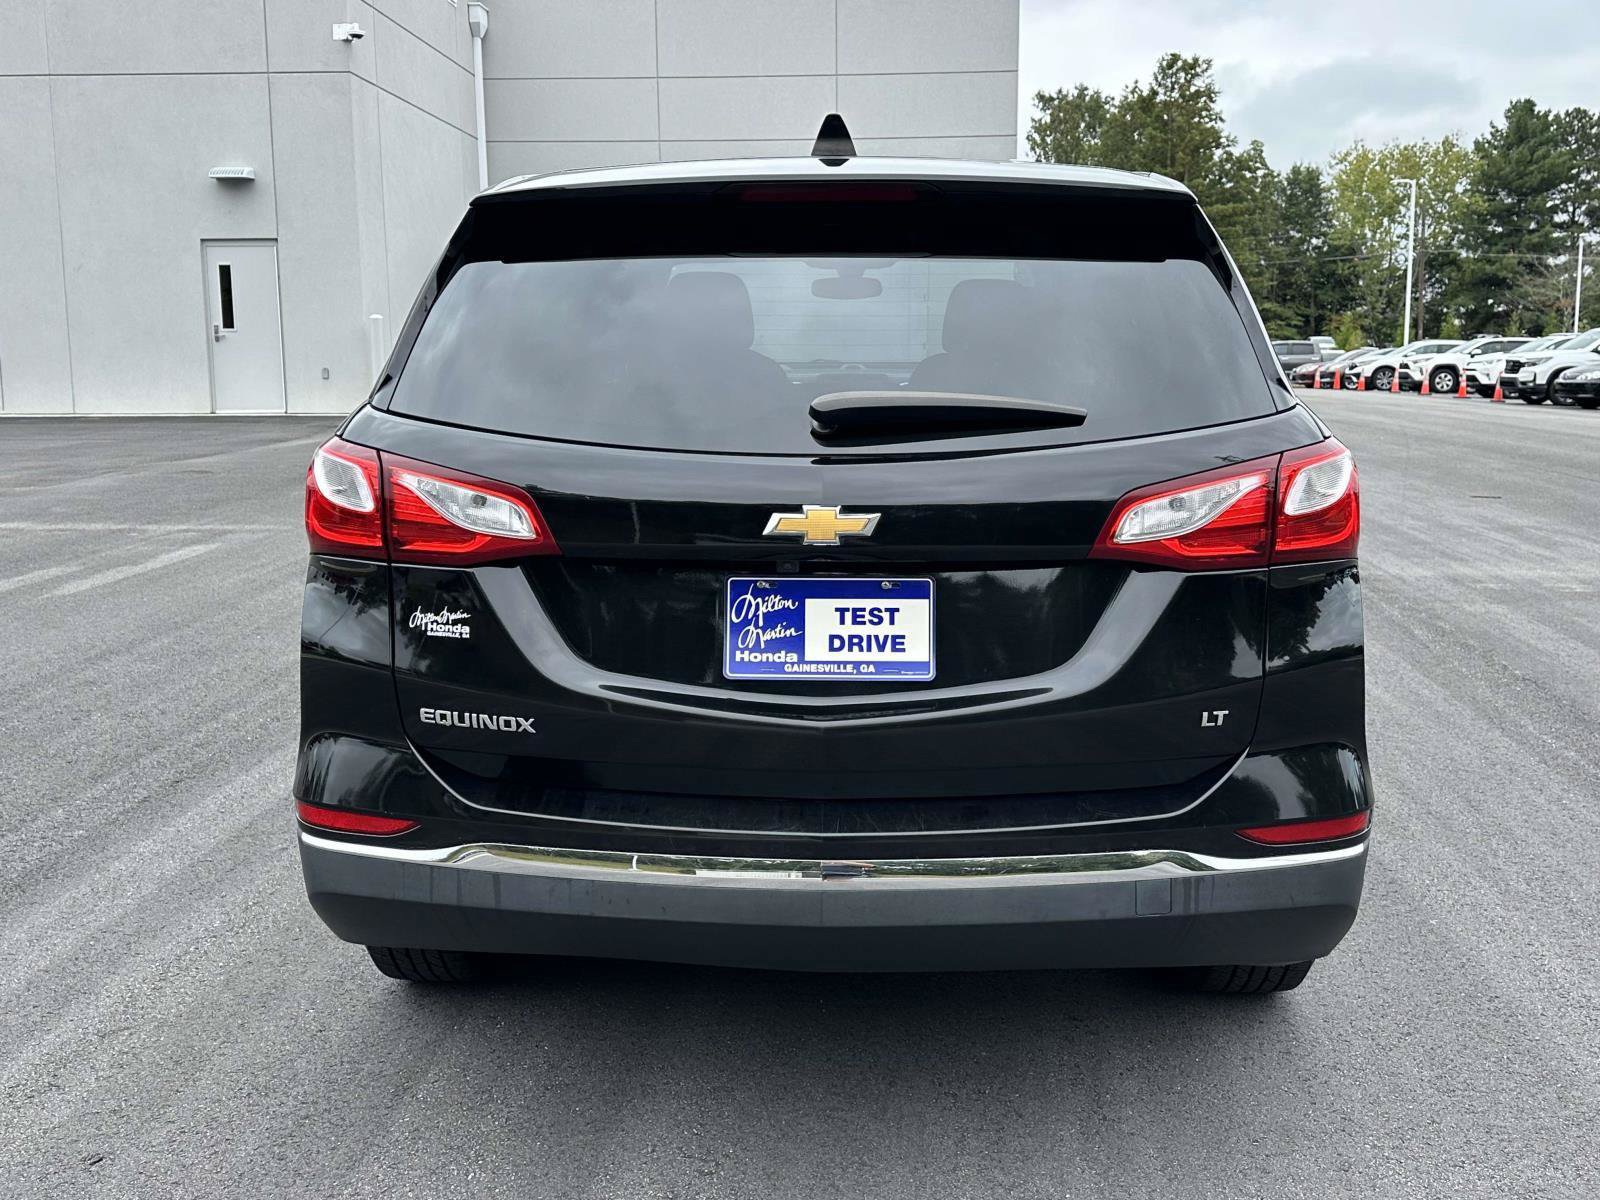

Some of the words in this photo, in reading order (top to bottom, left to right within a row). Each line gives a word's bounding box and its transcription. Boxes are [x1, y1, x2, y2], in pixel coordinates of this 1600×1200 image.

[731, 583, 799, 627] Milton
[834, 607, 900, 626] TEST
[426, 622, 470, 633] Honda
[738, 617, 803, 650] Martin
[828, 634, 906, 653] DRIVE
[735, 650, 798, 663] Honda
[784, 664, 857, 674] GAINESVILLE,
[860, 664, 876, 673] GA
[419, 707, 537, 734] EQUINOX
[1201, 710, 1230, 727] LT
